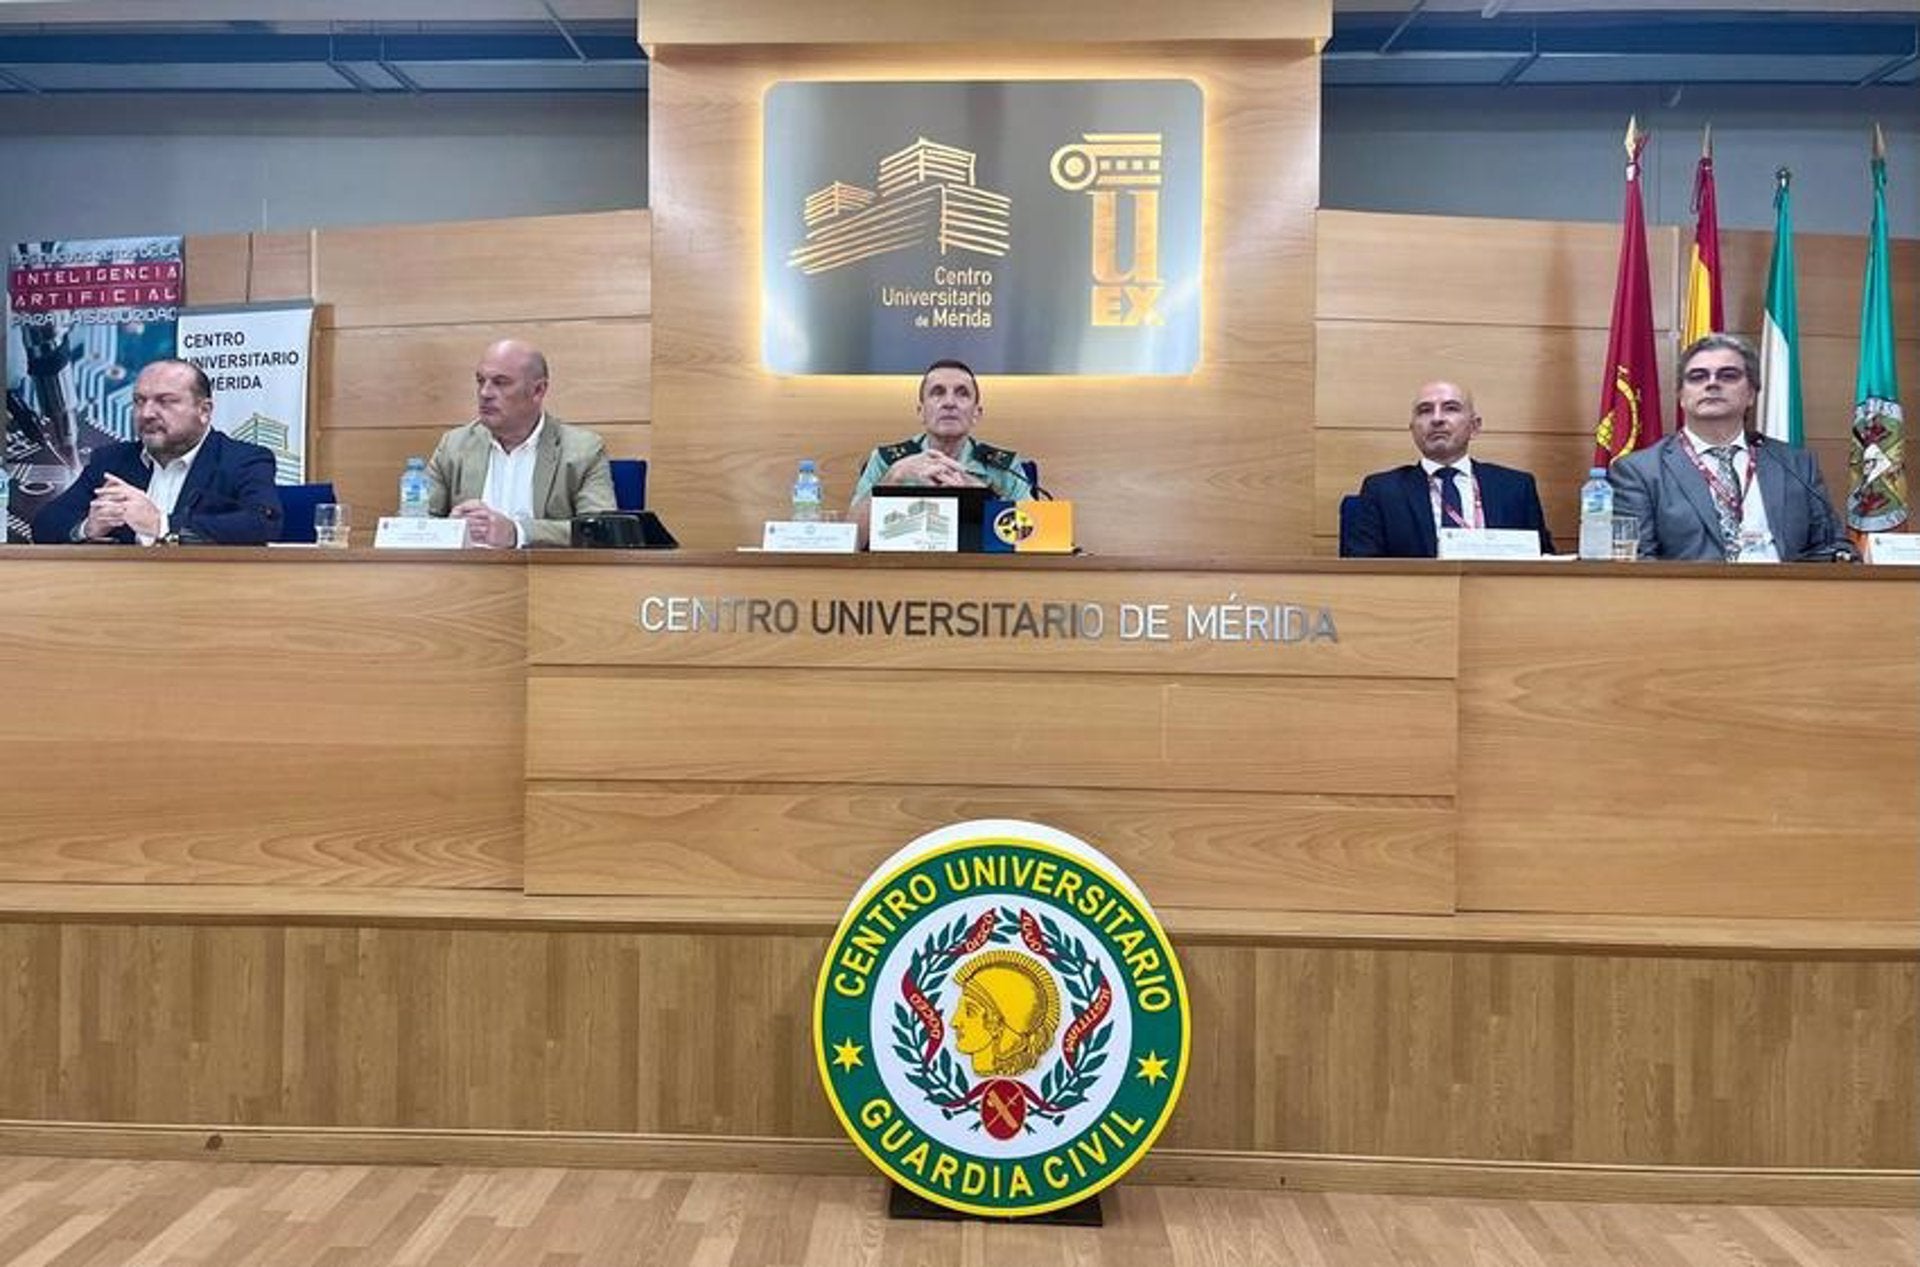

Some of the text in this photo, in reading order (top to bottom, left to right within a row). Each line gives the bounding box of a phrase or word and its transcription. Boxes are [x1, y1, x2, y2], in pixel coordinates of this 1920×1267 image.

[17, 266, 178, 286] INTELIGENCIA
[934, 266, 993, 286] Centro
[15, 287, 178, 307] ARTIFICIAL
[882, 287, 993, 306] Universitario
[914, 308, 993, 327] de Mérida
[183, 331, 245, 348] CENTRO
[640, 592, 1339, 643] CENTRO UNIVERSITARIO DE MÉRIDA
[834, 855, 1172, 1013] CENTRO UNIVERSITARIO
[860, 1098, 1146, 1199] GUARDIA CIVIL
